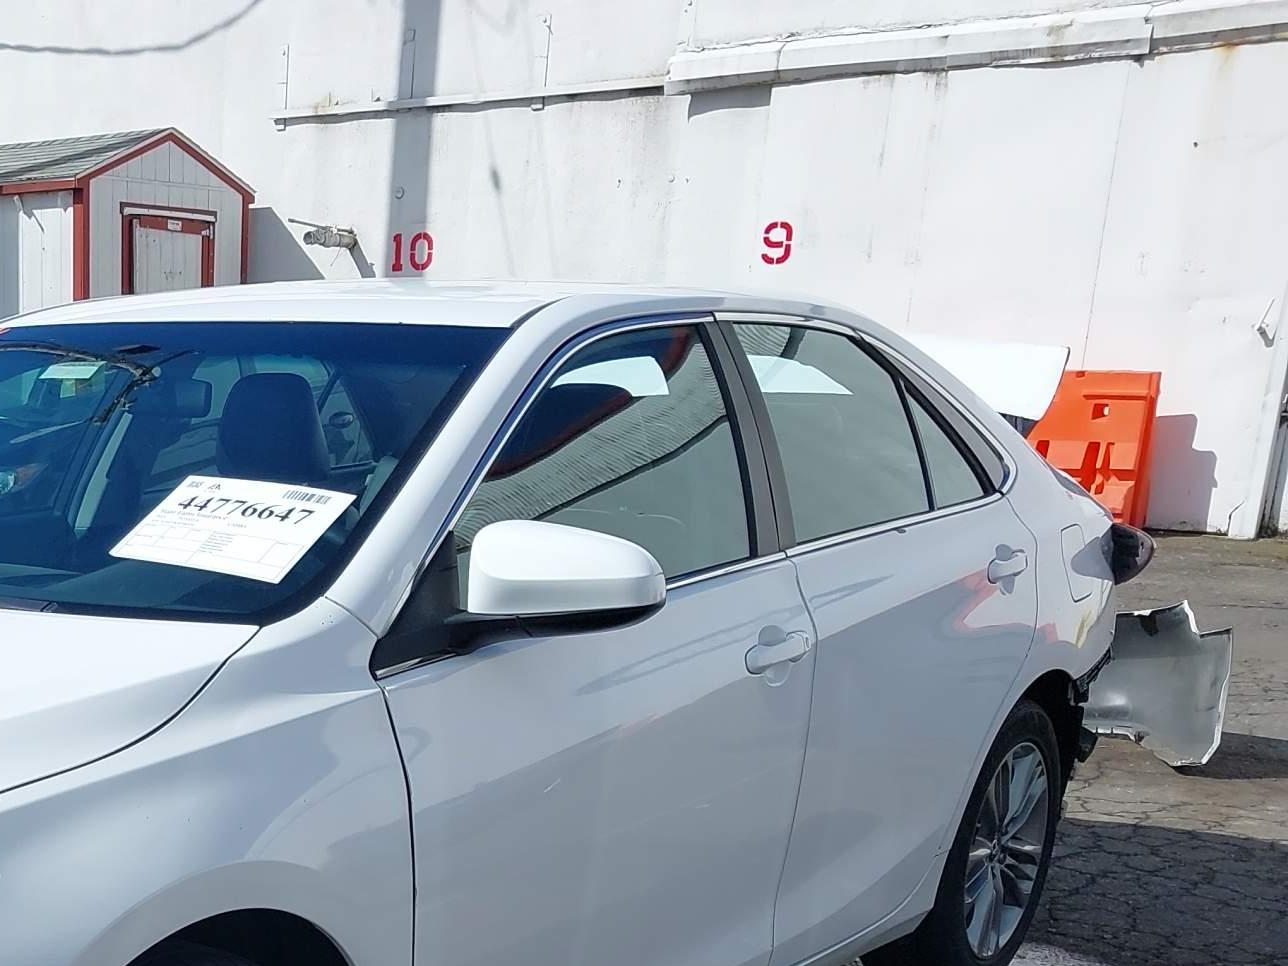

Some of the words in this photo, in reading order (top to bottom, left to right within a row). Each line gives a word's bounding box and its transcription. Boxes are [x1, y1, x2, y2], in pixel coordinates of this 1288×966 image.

[392, 232, 433, 272] 10
[761, 221, 793, 265] 9
[178, 496, 315, 525] 44776647
